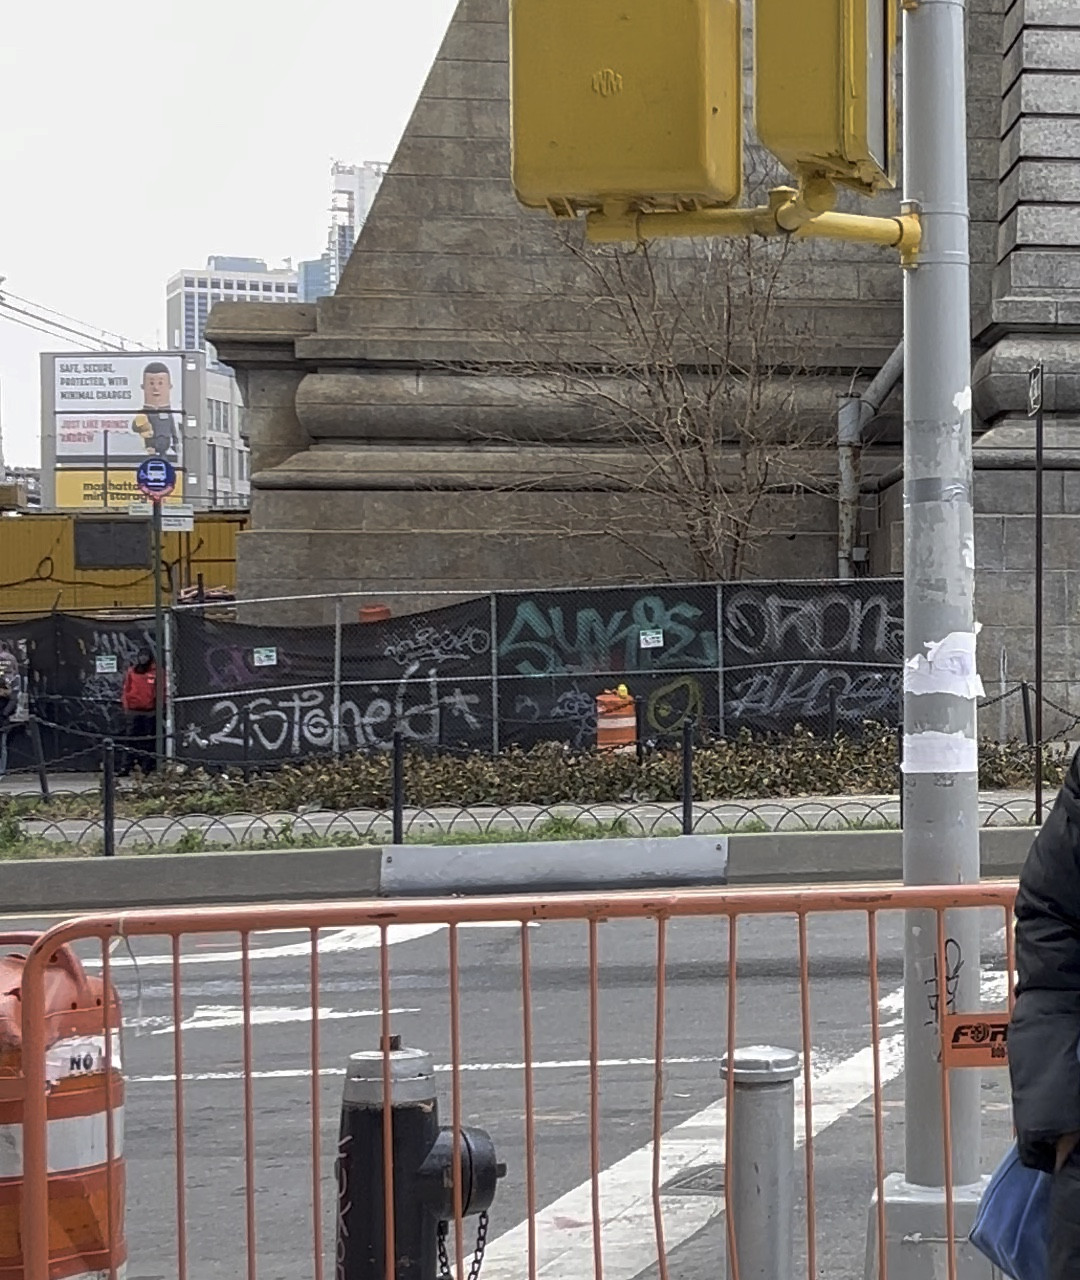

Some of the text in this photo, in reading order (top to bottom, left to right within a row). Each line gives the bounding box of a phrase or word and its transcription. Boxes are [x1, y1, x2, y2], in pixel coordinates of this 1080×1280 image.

[84, 480, 141, 490] manhatta
[110, 493, 148, 503] storag
[70, 1053, 94, 1071] NO
